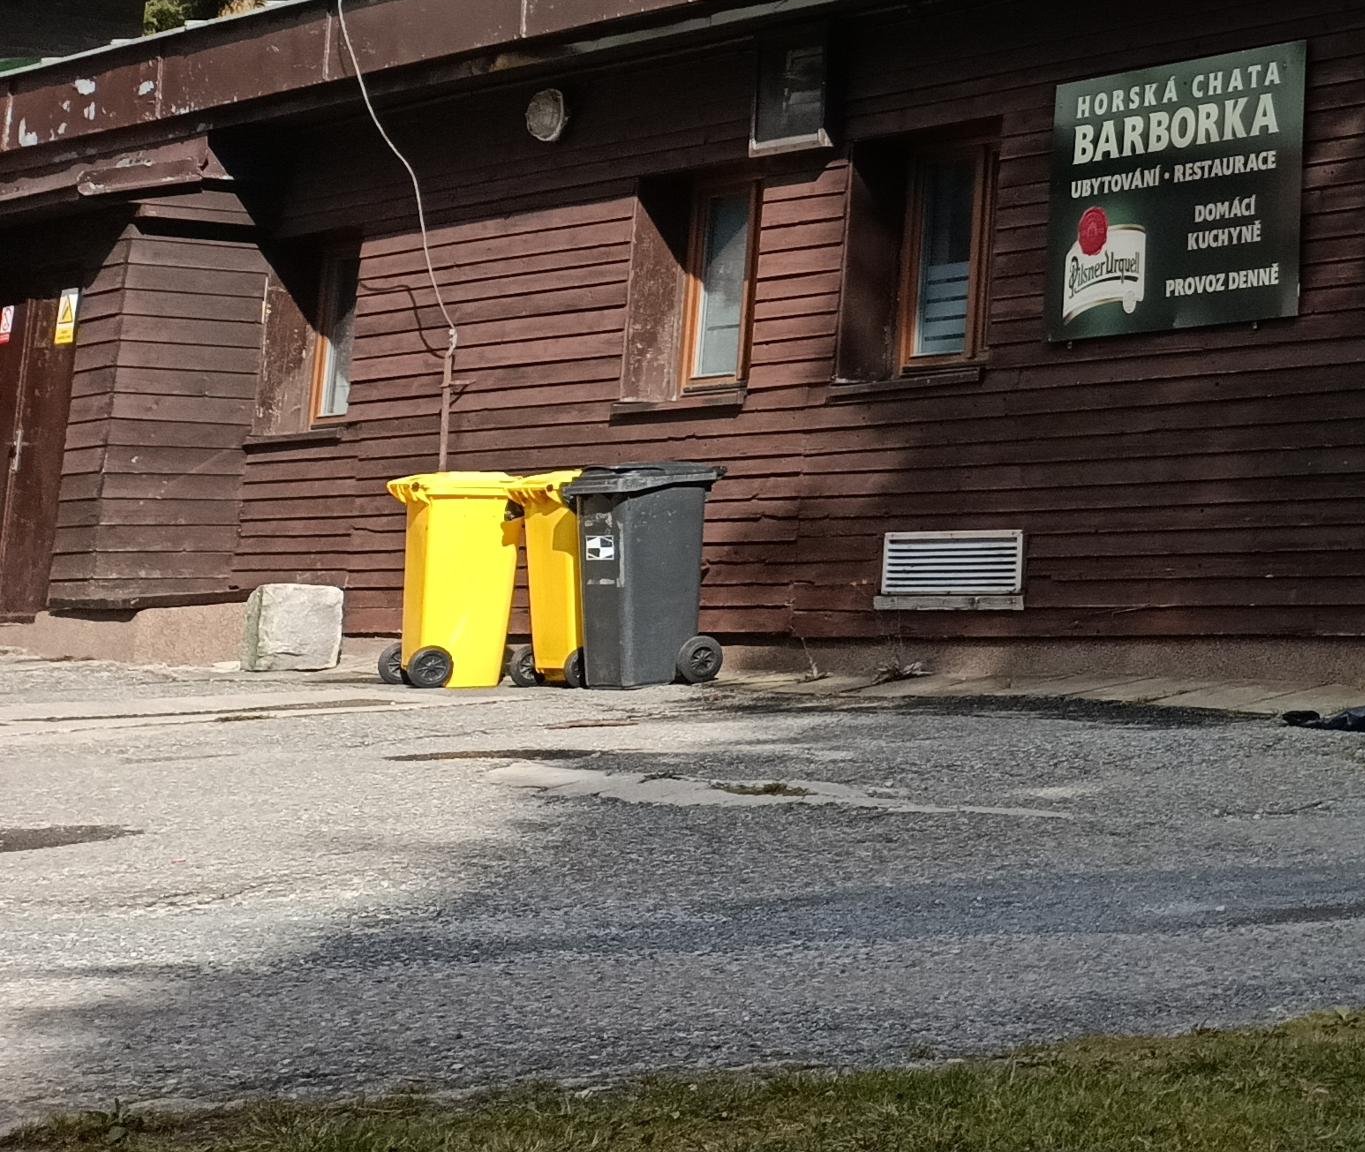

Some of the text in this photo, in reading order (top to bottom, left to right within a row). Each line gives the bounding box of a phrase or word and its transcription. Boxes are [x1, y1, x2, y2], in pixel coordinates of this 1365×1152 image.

[1076, 61, 1281, 118] HORSKÁ CHATA
[1072, 93, 1280, 165] BARBORKA
[1071, 150, 1278, 198] UBYTOVÁNÍ RESTAURACE
[1194, 194, 1256, 223] DOMÁCÍ
[1187, 220, 1262, 250] KUCHYNĚ
[1068, 250, 1139, 299] Pilsner Urquell
[1165, 263, 1279, 297] PROVOZ DENNĚ
